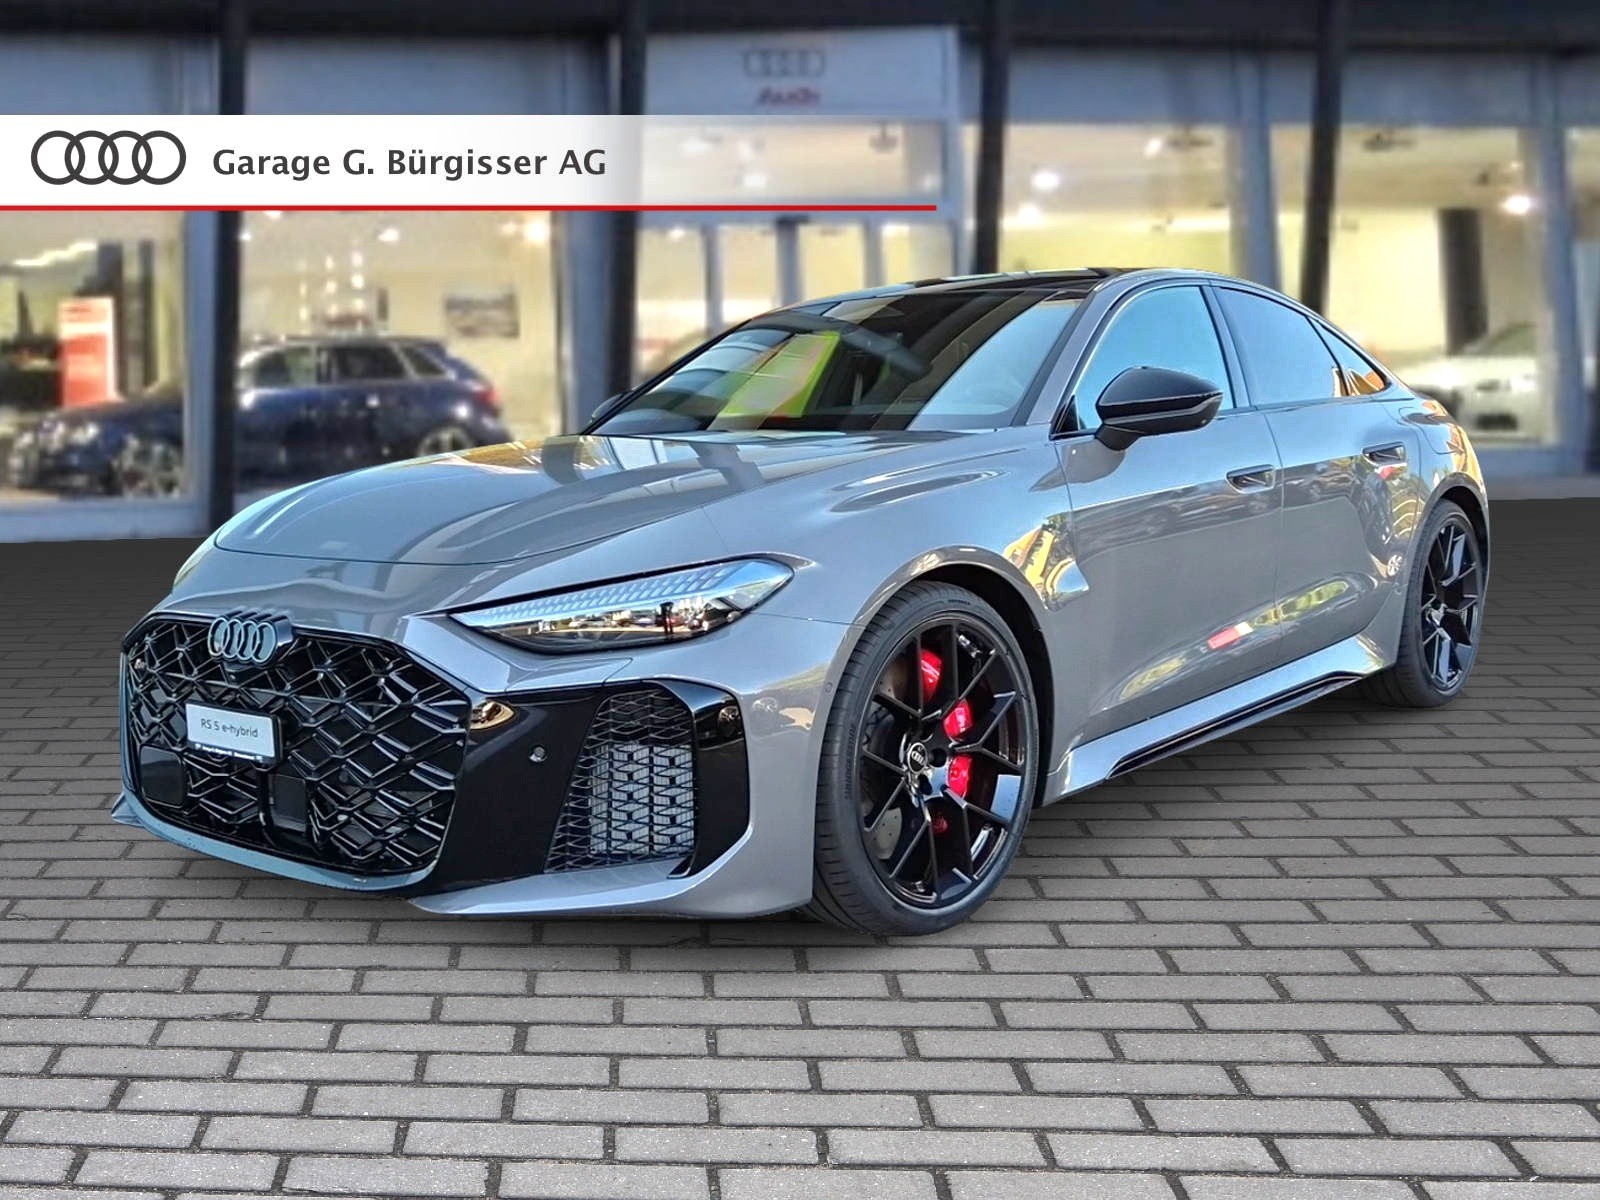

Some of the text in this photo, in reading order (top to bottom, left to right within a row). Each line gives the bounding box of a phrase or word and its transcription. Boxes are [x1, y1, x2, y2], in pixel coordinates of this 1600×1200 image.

[200, 718, 258, 738] RS 5 e-hybrid
